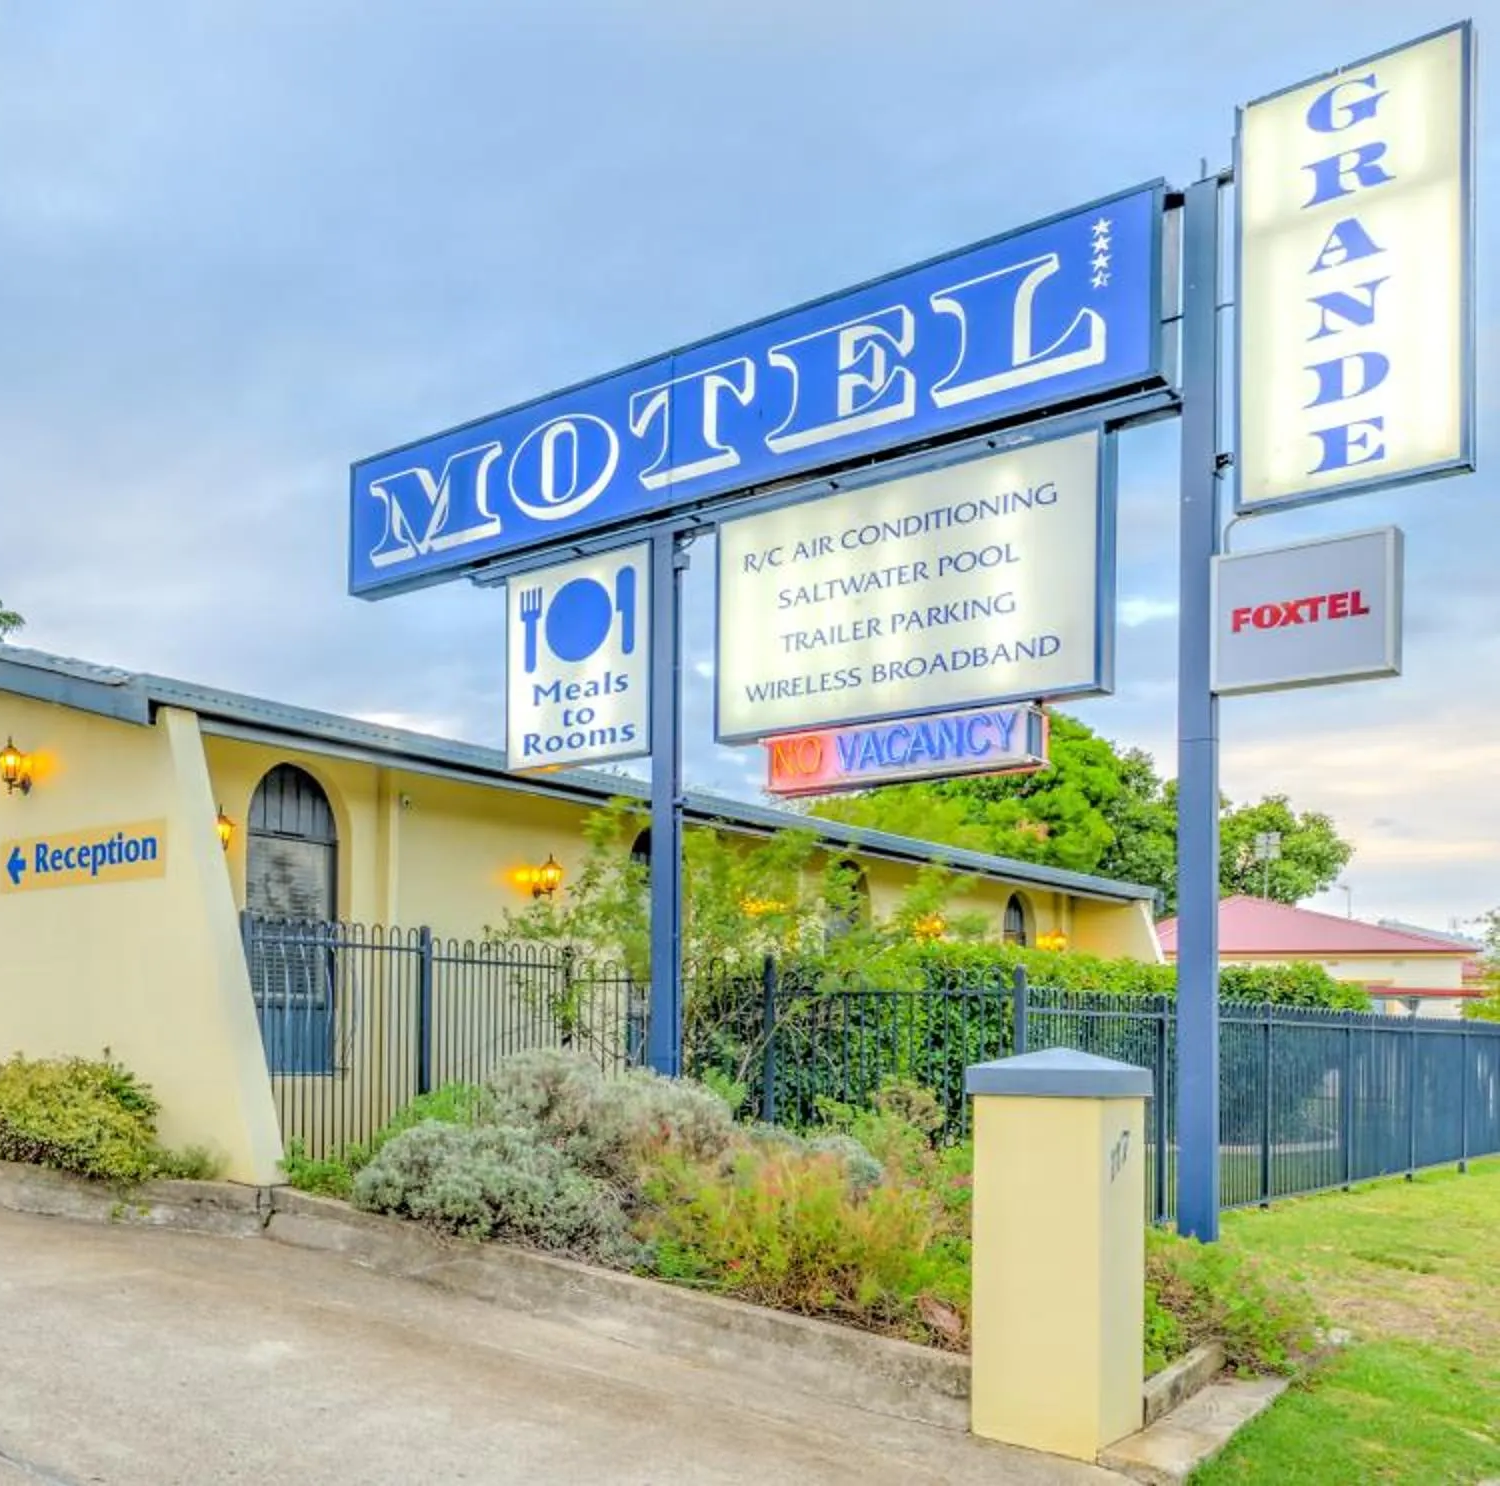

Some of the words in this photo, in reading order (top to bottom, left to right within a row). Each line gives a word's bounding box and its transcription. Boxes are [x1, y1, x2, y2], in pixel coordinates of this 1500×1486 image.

[1301, 73, 1397, 475] GRANDE
[370, 252, 1107, 569] MOTEL
[743, 547, 784, 574] R/C
[793, 535, 835, 564] AIR
[841, 482, 1058, 551] CONDITIONING
[778, 561, 929, 609] SALTWATER
[939, 543, 1021, 577] POOL
[781, 617, 882, 654] TRAILER
[892, 592, 1017, 634] PARKING
[1231, 590, 1369, 633] FOXTEL
[533, 671, 629, 707] Meals
[745, 667, 861, 703] WIRELESS
[872, 635, 1061, 684] BROADBAND
[523, 723, 635, 756] Rooms
[563, 707, 595, 727] to
[772, 735, 823, 777] NO
[836, 711, 1019, 772] VACANCY
[34, 832, 158, 880] Reception
